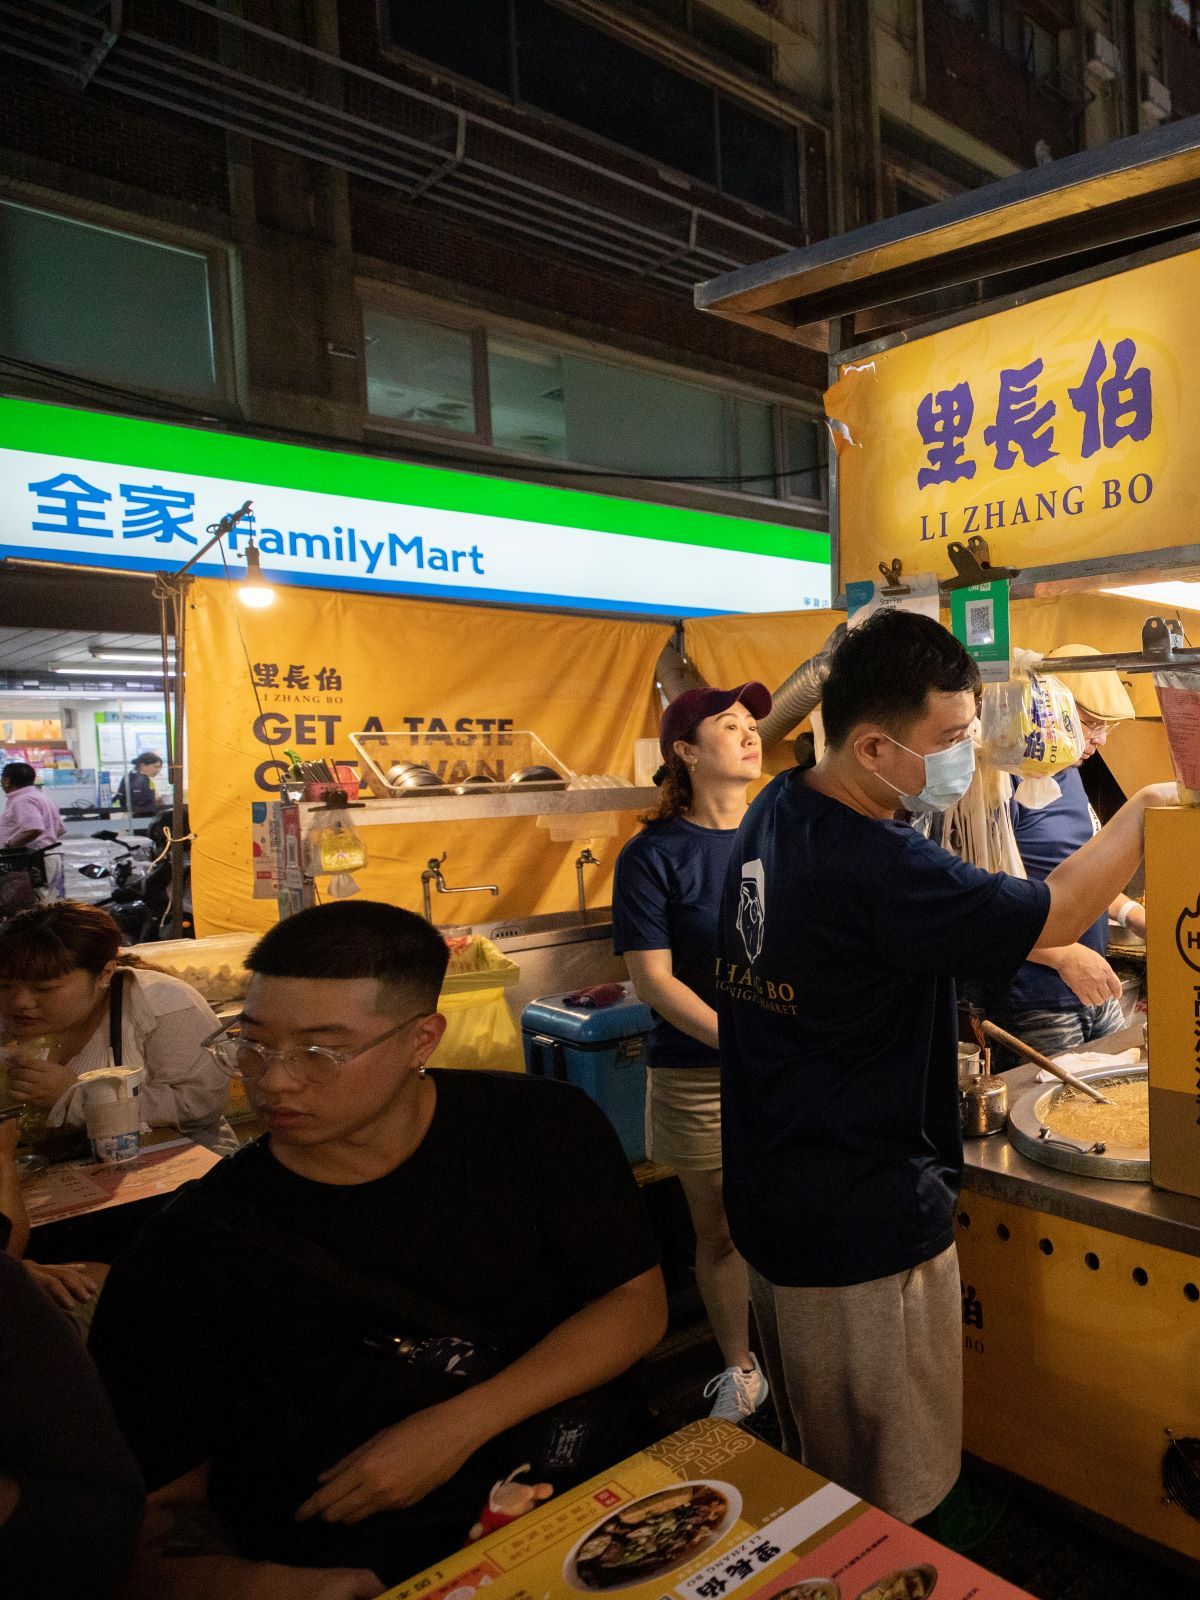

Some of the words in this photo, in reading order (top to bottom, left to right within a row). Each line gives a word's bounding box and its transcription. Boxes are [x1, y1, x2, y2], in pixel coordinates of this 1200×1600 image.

[917, 338, 1152, 490] 里長伯
[27, 472, 198, 546] 全家
[919, 511, 948, 541] LI
[962, 485, 1085, 535] ZHANG
[1101, 472, 1154, 510] BO
[225, 514, 486, 576] FamilyMart
[253, 663, 342, 692] 里長伯
[274, 693, 321, 704] ZHANG
[326, 695, 344, 704] BO
[253, 712, 342, 746] GET
[359, 716, 388, 745] A
[403, 717, 514, 746] TASTE
[766, 980, 795, 1002] BO
[662, 1423, 741, 1473] TAST
[694, 1434, 756, 1474] GET
[749, 1534, 762, 1545] LI
[695, 1540, 781, 1598] 里長伯
[706, 1543, 749, 1574] ZHANG
[686, 1574, 704, 1587] BO
